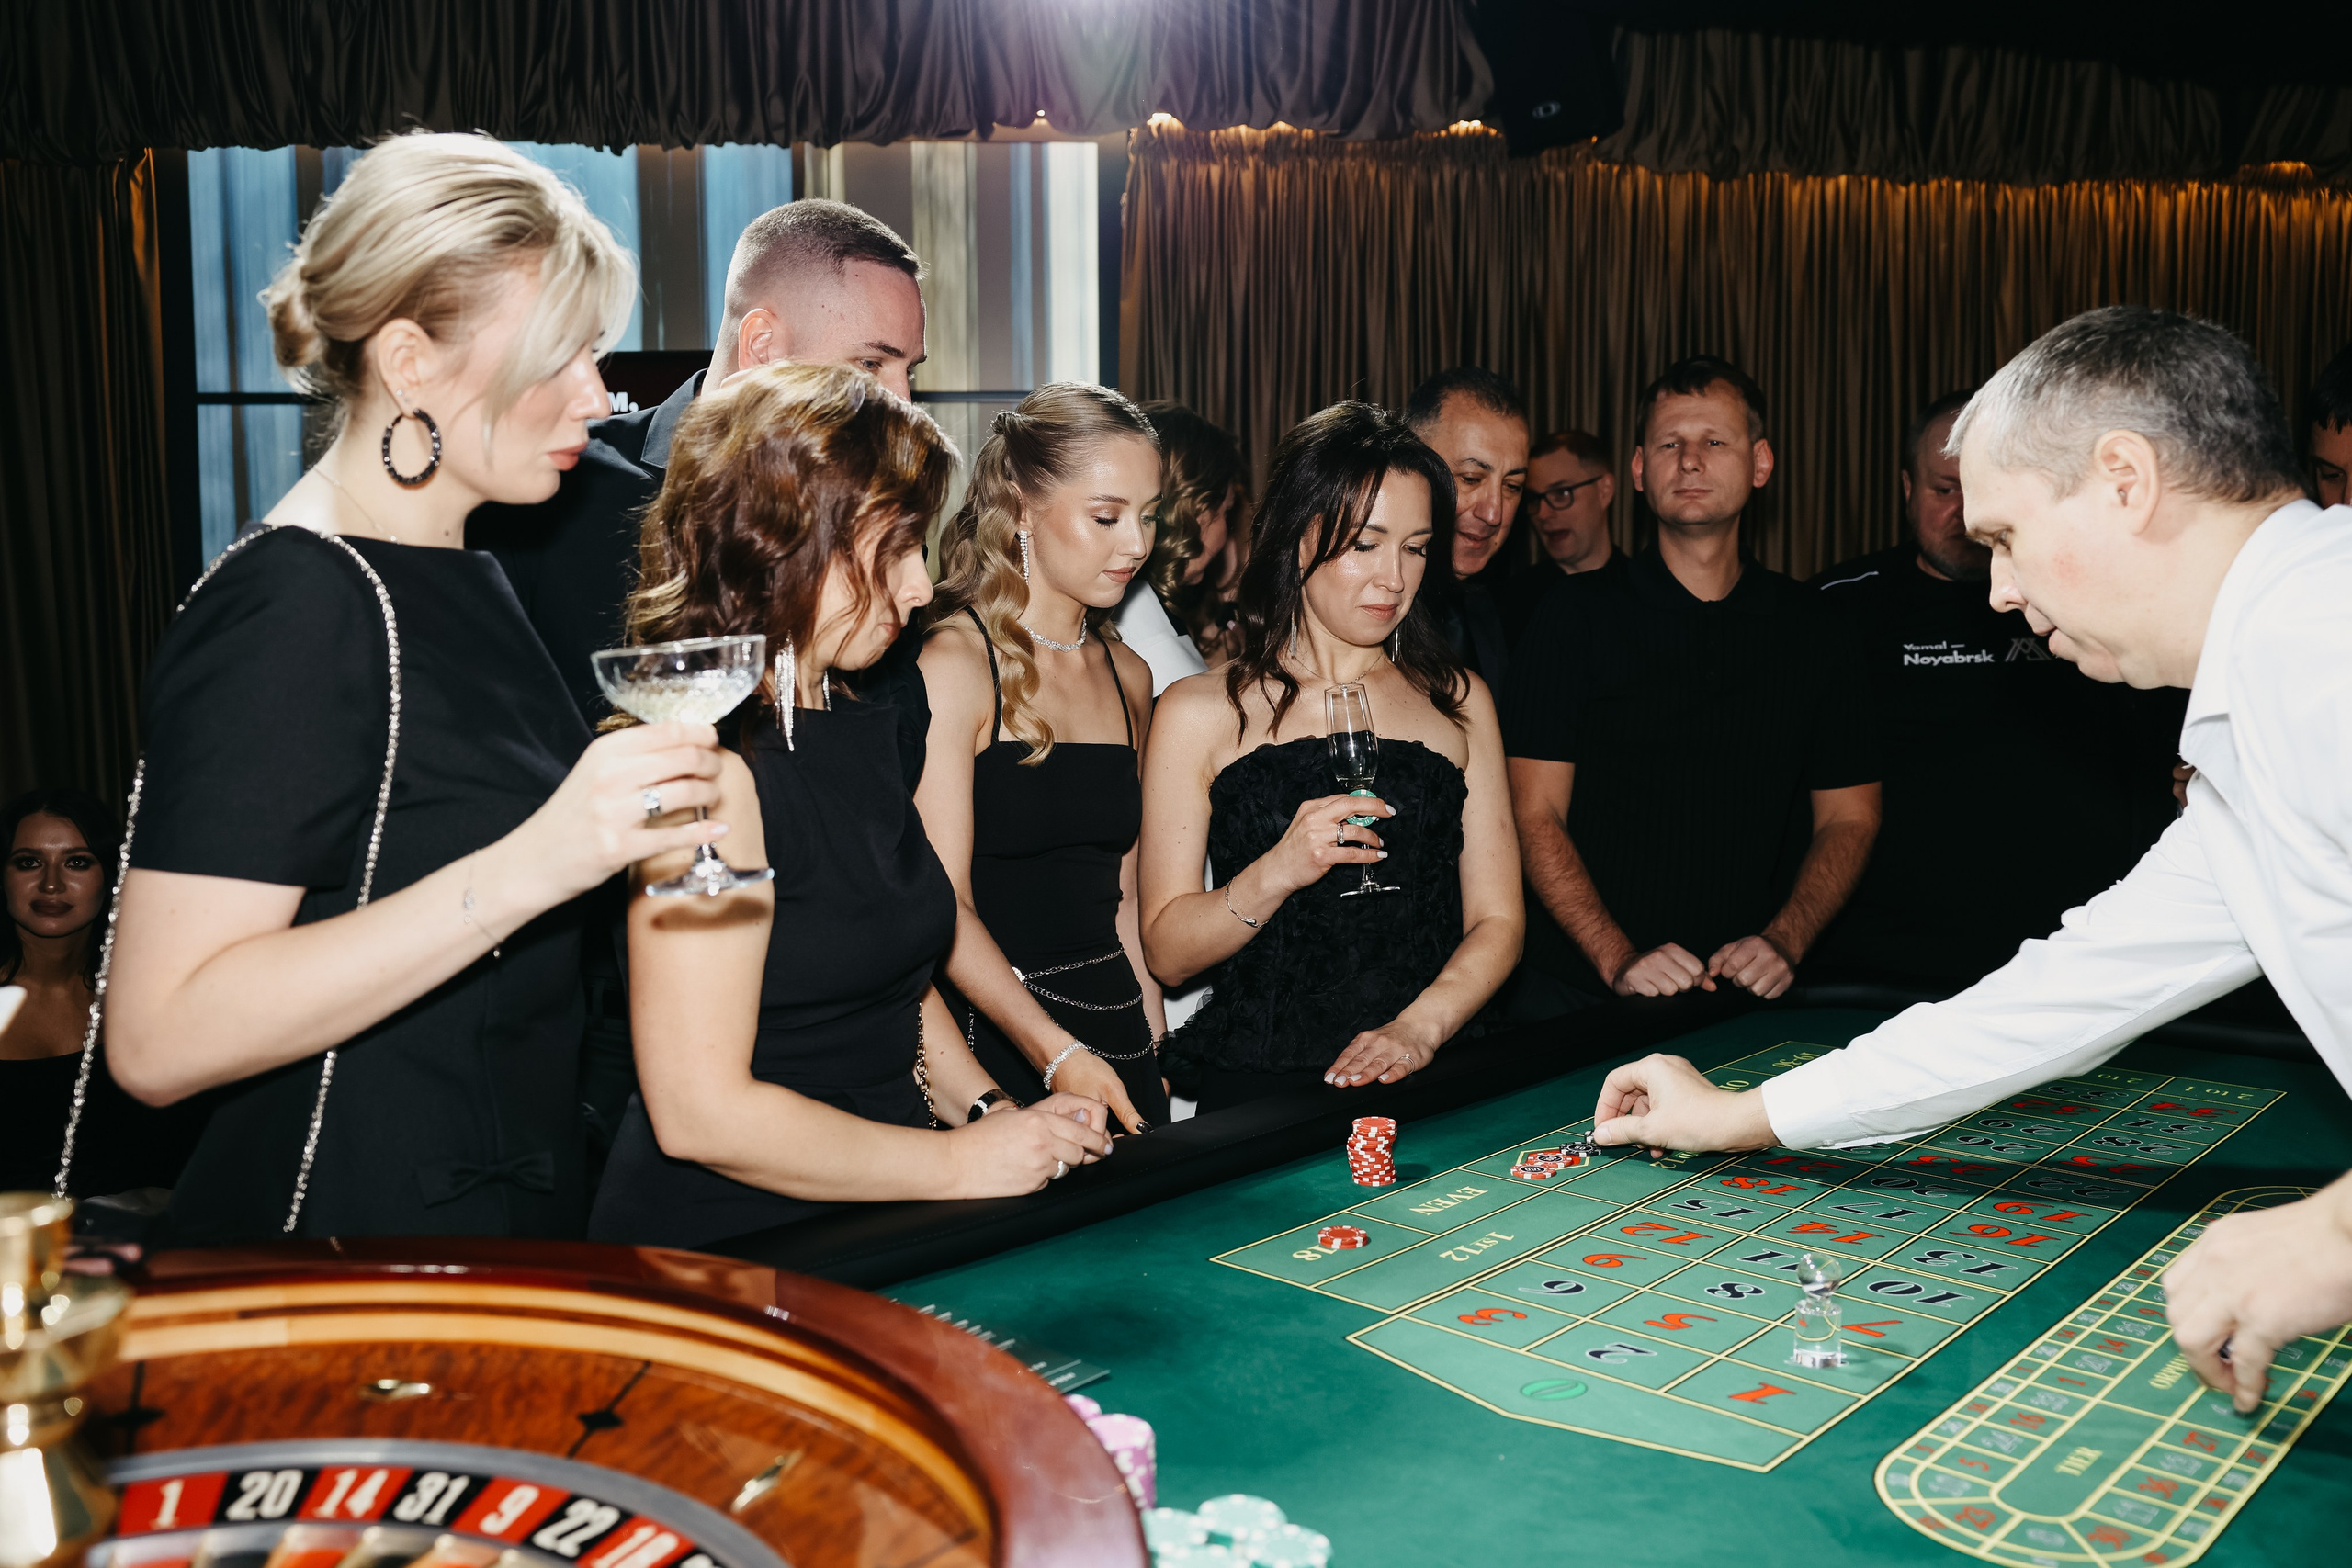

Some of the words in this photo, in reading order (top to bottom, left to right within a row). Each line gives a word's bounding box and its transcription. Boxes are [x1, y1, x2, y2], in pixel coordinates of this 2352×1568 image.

[1903, 641, 1947, 651] Yamal
[1903, 649, 1995, 666] Noyabrsk
[2205, 1088, 2230, 1097] to
[2238, 1092, 2254, 1100] 2
[2011, 1100, 2101, 1115] 32
[2148, 1101, 2239, 1118] 34
[1978, 1118, 2072, 1135] 29
[2120, 1117, 2214, 1134] 31
[1939, 1135, 2043, 1154] 26
[2091, 1135, 2191, 1155] 28
[1649, 1156, 1687, 1170] 12
[1764, 1154, 1849, 1173] 21
[1906, 1156, 2003, 1176] 23
[2060, 1156, 2161, 1176] 25
[1720, 1175, 1808, 1197] 18
[1870, 1176, 1969, 1198] 20
[2026, 1177, 2130, 1199] 22
[1408, 1186, 1488, 1216] EVEN
[1668, 1198, 1765, 1221] 15
[1827, 1201, 1927, 1221] 17
[1993, 1201, 2093, 1223] 19
[1620, 1221, 1714, 1246] 12
[1786, 1220, 1885, 1246] 14
[1949, 1224, 2061, 1247] 16
[1582, 1252, 1647, 1269] 9
[1911, 1248, 2018, 1279] 13
[1517, 1279, 1587, 1296] 6
[1703, 1281, 1766, 1299] 8
[1866, 1280, 1975, 1308] 10
[1457, 1308, 1528, 1326] 3
[1642, 1313, 1719, 1330] 5
[1840, 1319, 1904, 1337] 7
[1585, 1341, 1658, 1364] 2
[2097, 1337, 2131, 1354] 14
[2075, 1354, 2113, 1374] 20
[1519, 1378, 1589, 1401] 0
[2057, 1375, 2086, 1388] 1
[1728, 1382, 1797, 1405] 1
[2008, 1410, 2047, 1431] 16
[1958, 1456, 1991, 1472] 5
[2053, 1445, 2104, 1477] TIER
[224, 1468, 305, 1522] 20
[313, 1467, 390, 1520] 14
[392, 1471, 471, 1525] 31
[149, 1477, 185, 1531] 1
[478, 1483, 541, 1536] 9
[531, 1497, 621, 1559] 22
